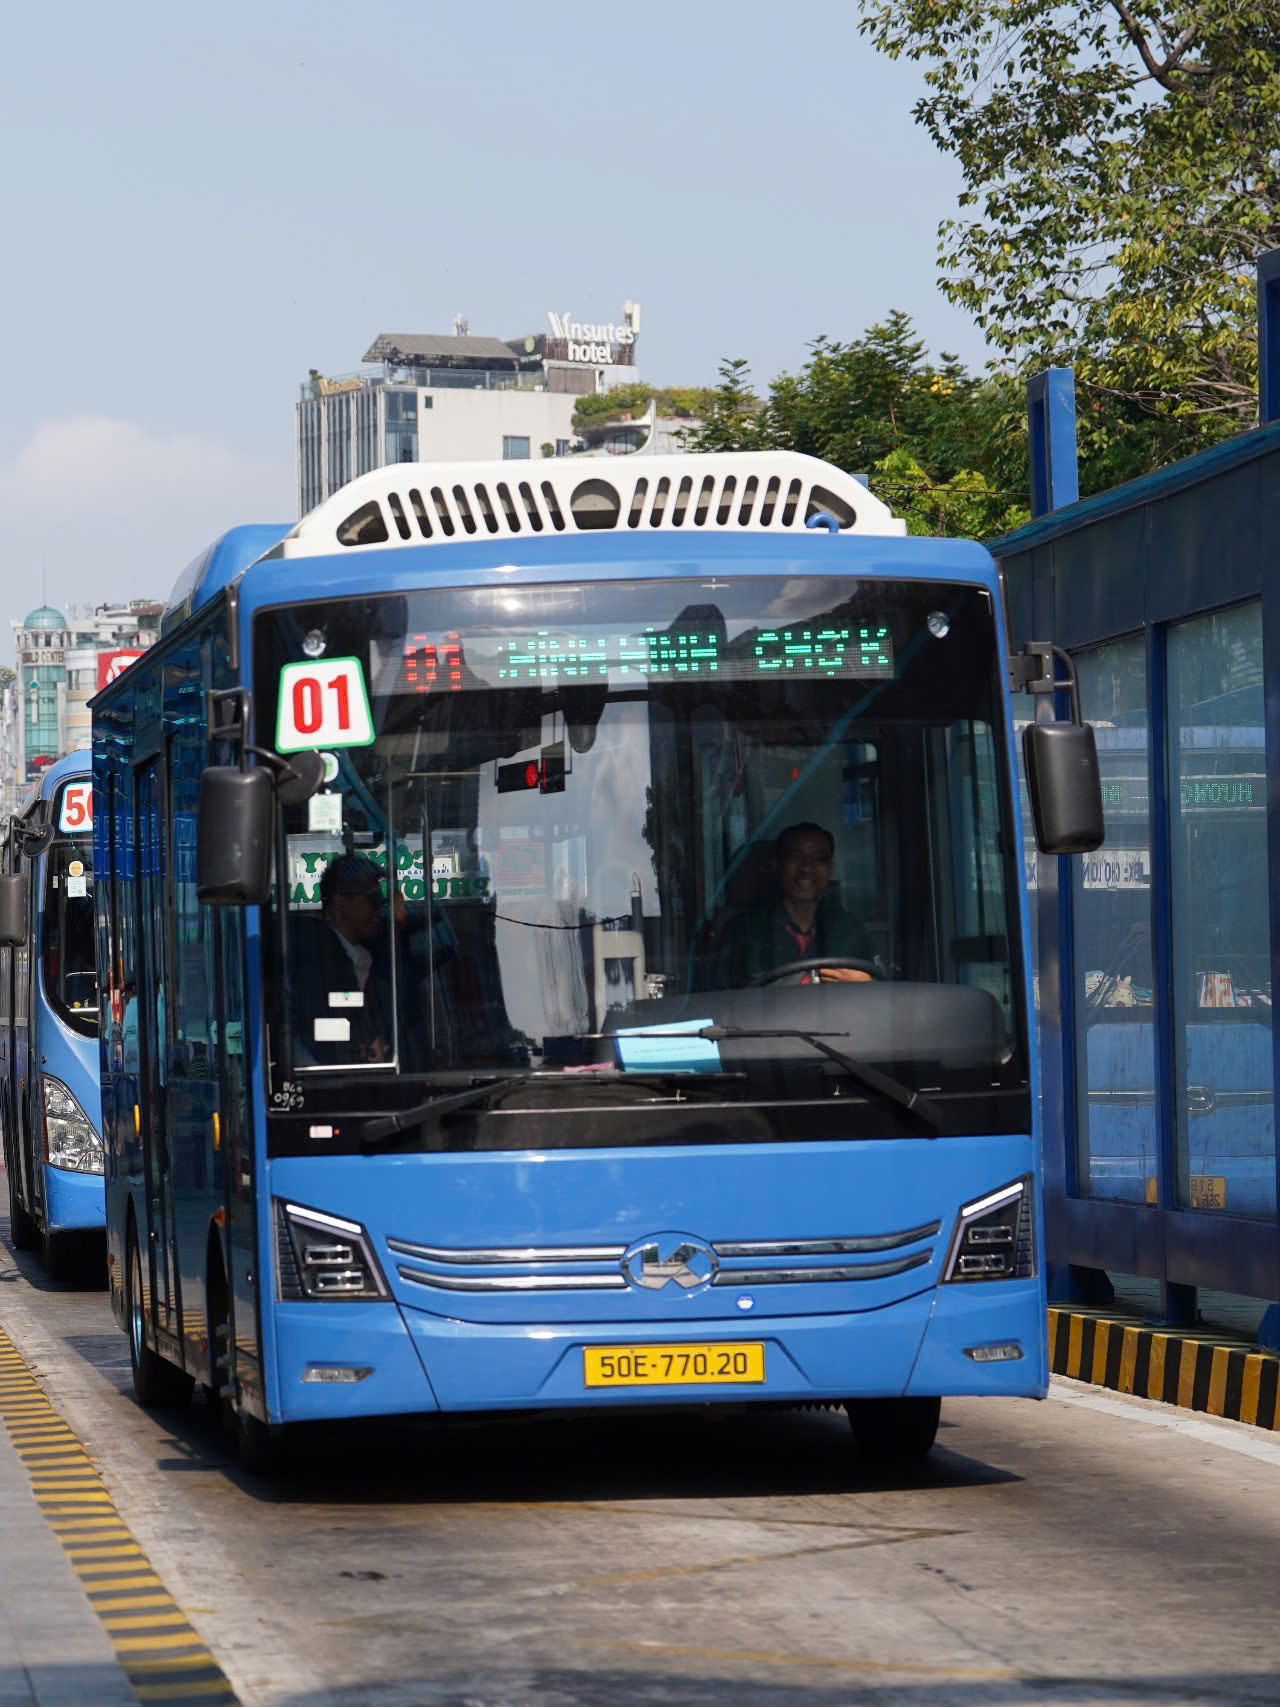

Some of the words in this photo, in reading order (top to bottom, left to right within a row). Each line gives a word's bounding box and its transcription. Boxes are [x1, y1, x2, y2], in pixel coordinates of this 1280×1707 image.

[568, 340, 613, 364] hotel
[292, 673, 350, 734] 01
[600, 1352, 748, 1379] 50E-770.20
